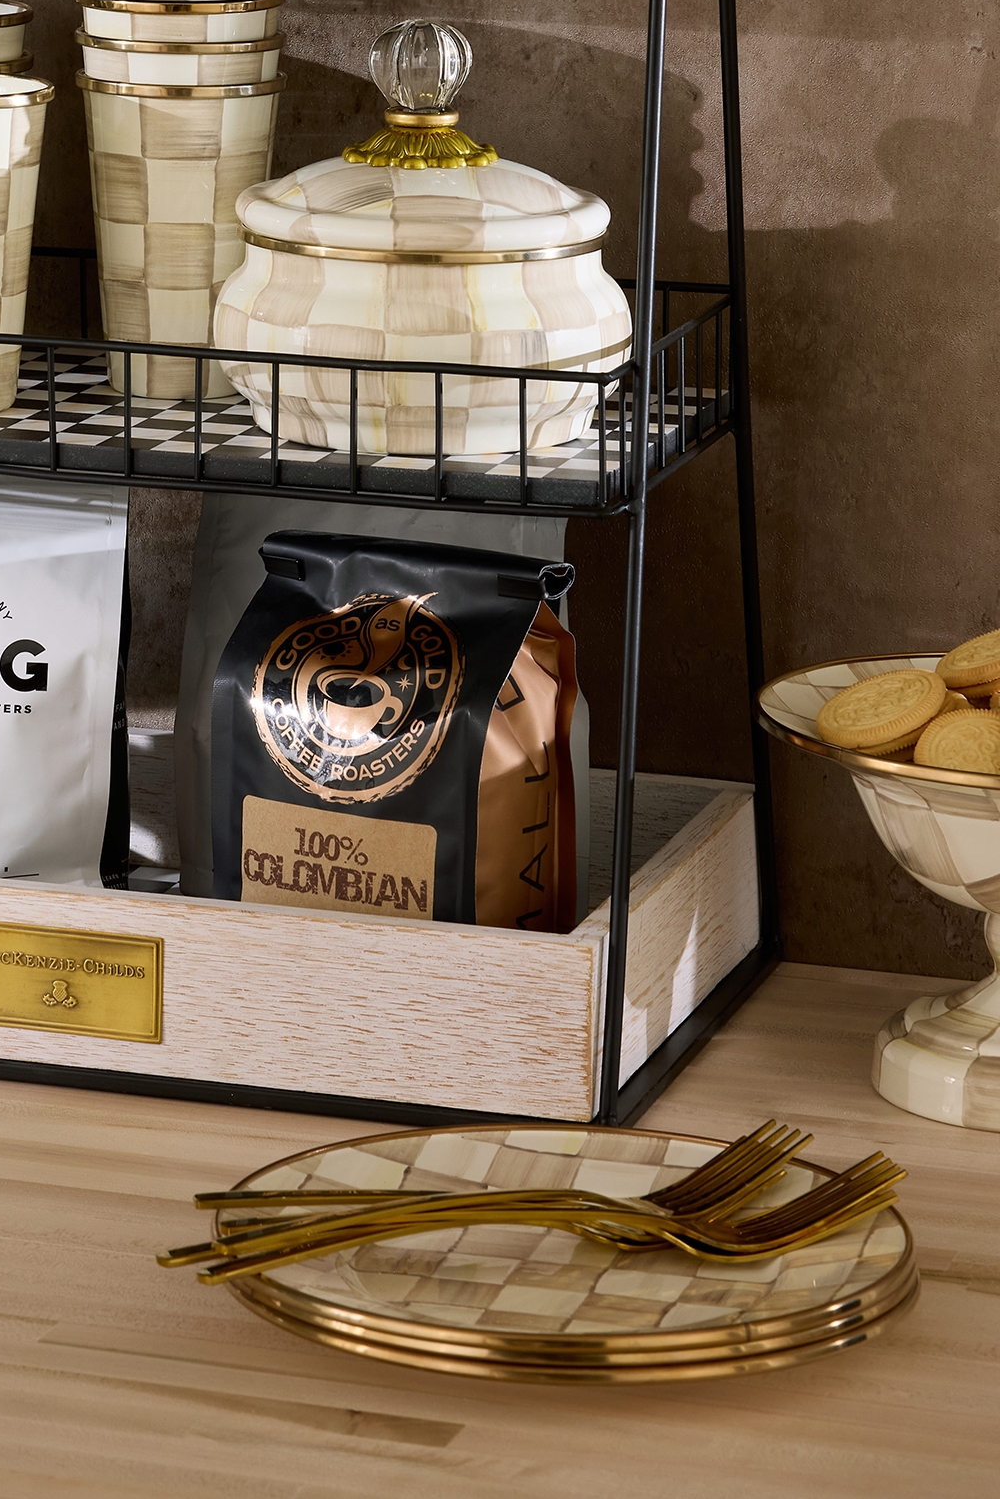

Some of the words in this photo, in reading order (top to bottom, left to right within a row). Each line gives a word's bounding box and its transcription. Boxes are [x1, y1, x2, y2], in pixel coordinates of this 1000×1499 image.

[275, 616, 361, 672] GOOD
[374, 617, 401, 632] as
[410, 624, 447, 690] GOLD
[271, 697, 321, 772] COFFEE
[330, 717, 426, 783] ROASTERS
[243, 847, 428, 913] COLOMBIAN
[293, 827, 369, 866] 100%
